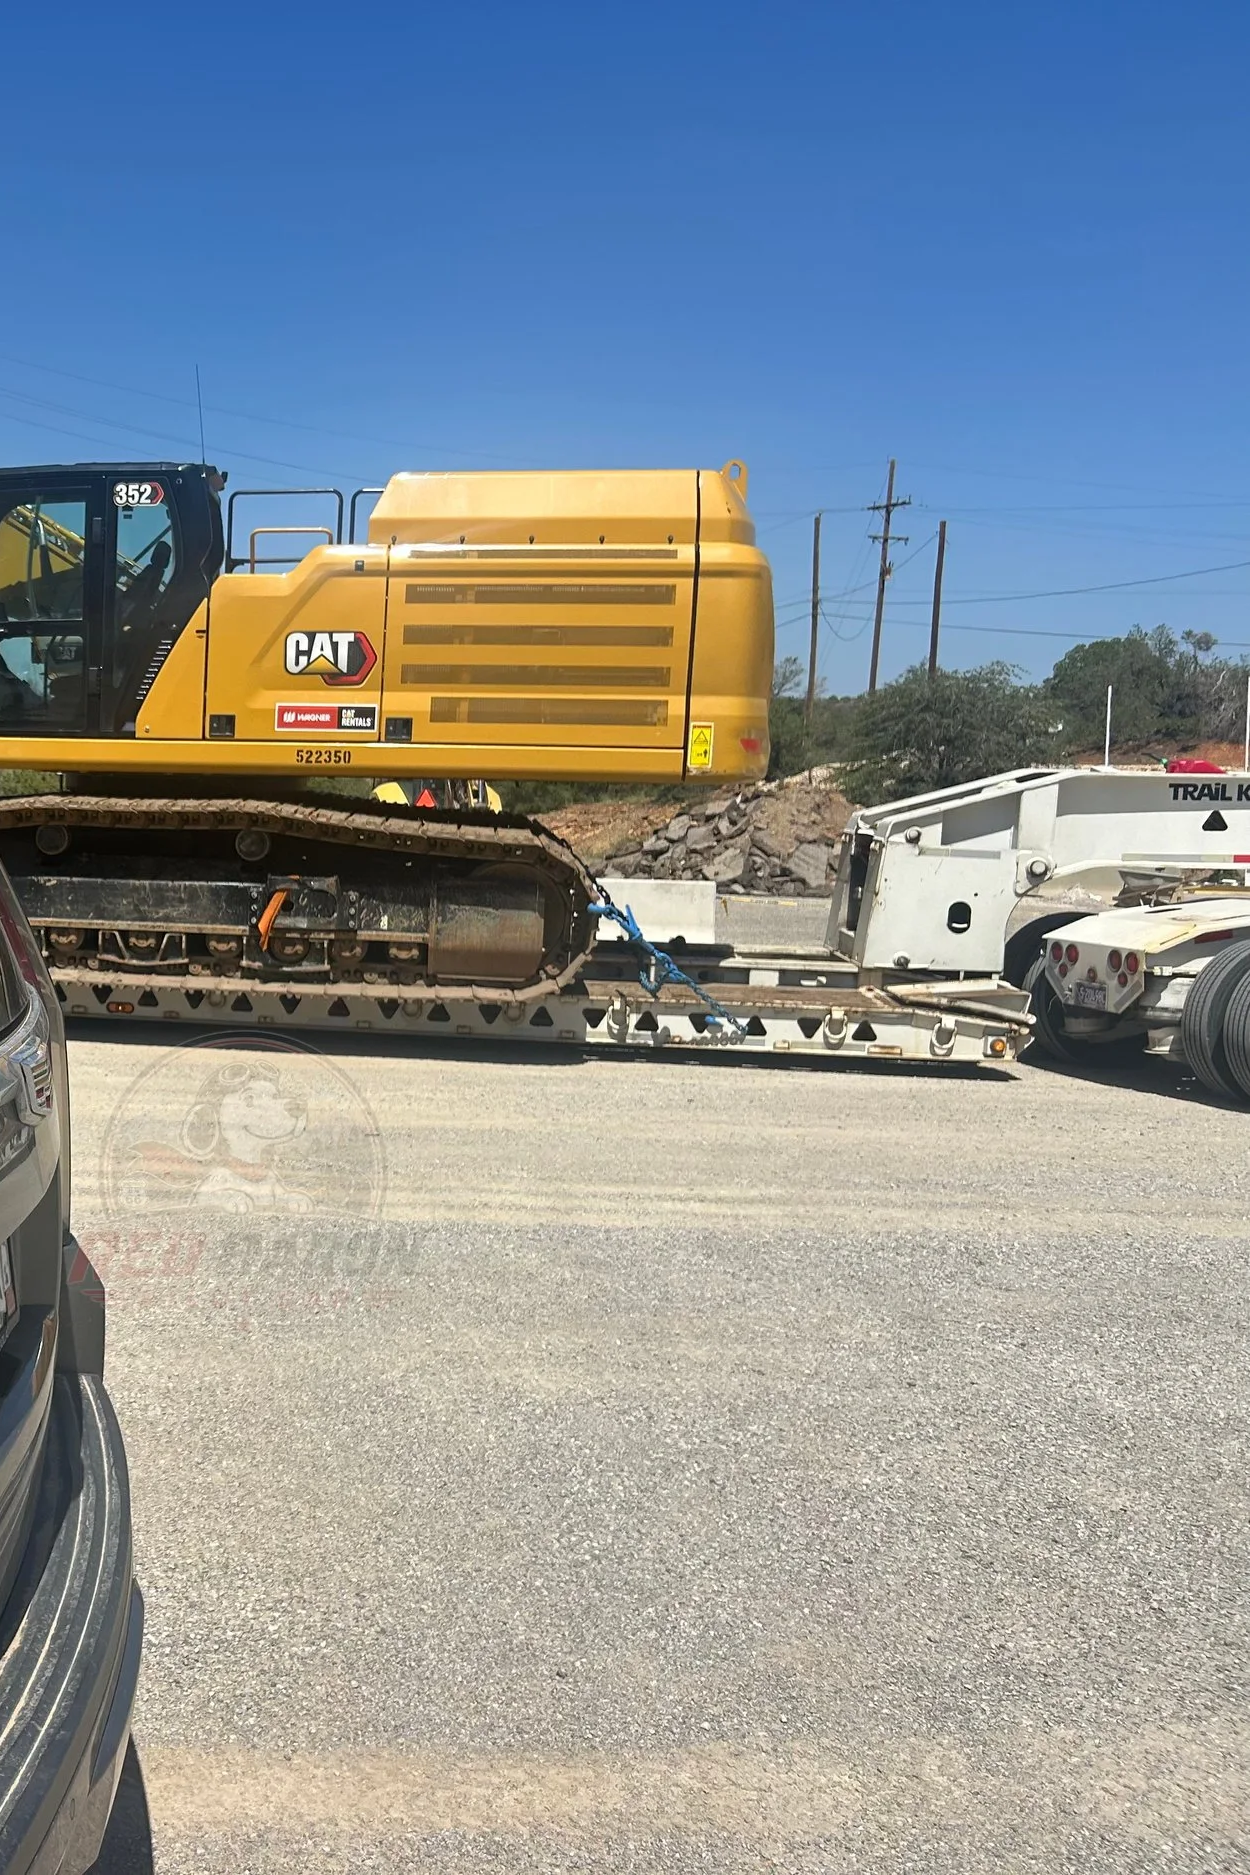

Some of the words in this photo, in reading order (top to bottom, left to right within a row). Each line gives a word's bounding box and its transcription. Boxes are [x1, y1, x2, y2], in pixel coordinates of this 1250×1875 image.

[115, 484, 152, 504] 352
[286, 632, 355, 674] CAT
[297, 713, 331, 722] WAGNER
[342, 709, 356, 718] CAT
[341, 718, 372, 727] RENTALS
[296, 749, 352, 764] 522350
